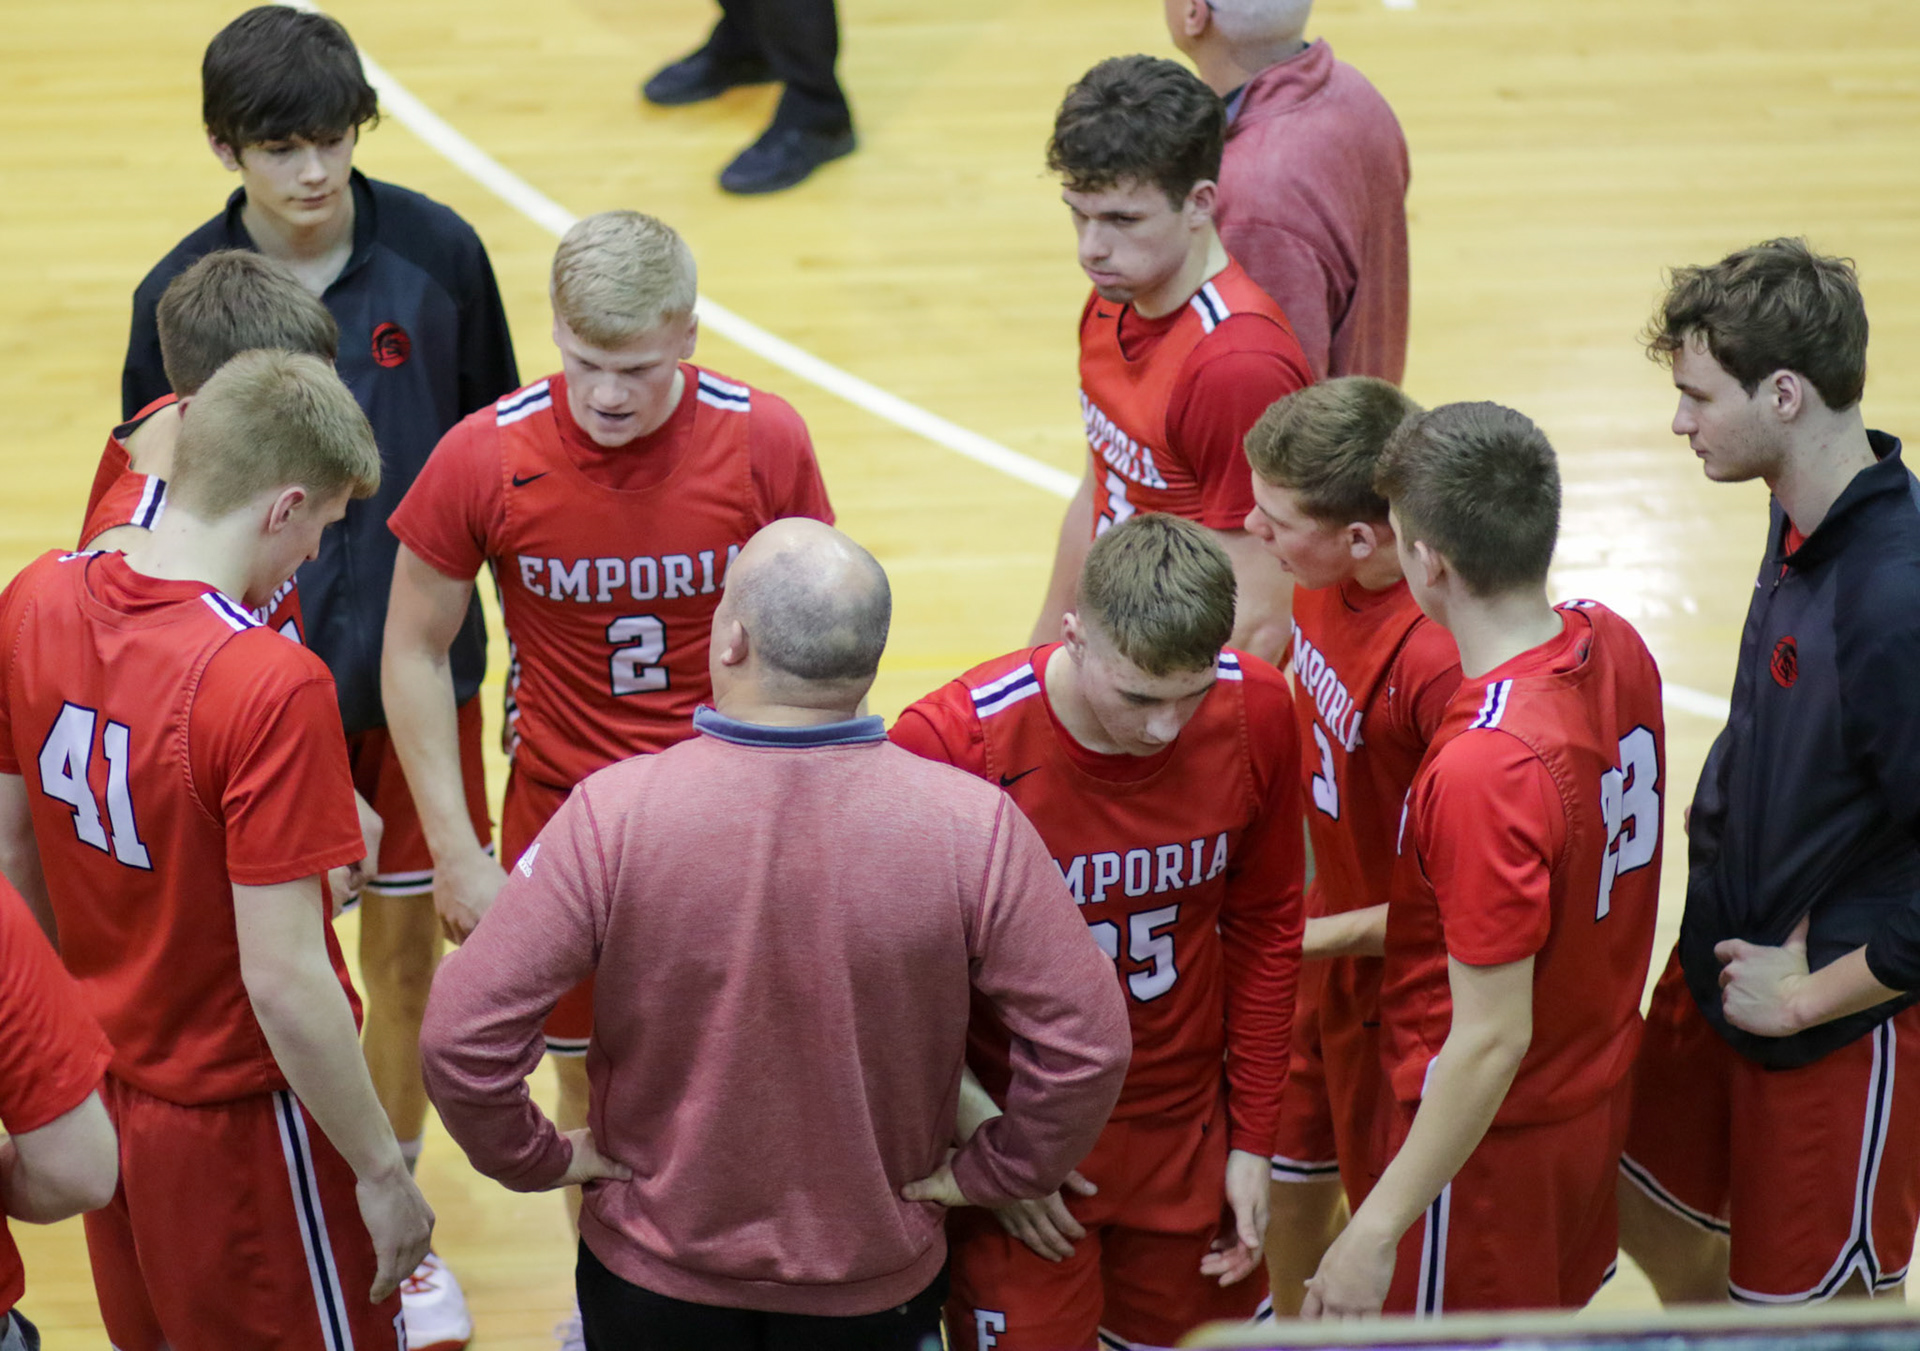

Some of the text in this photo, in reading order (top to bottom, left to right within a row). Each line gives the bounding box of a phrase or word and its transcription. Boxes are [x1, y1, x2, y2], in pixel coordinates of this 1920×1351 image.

[606, 614, 670, 697] 2
[38, 700, 154, 872] 41
[1053, 831, 1229, 906] MPORIA
